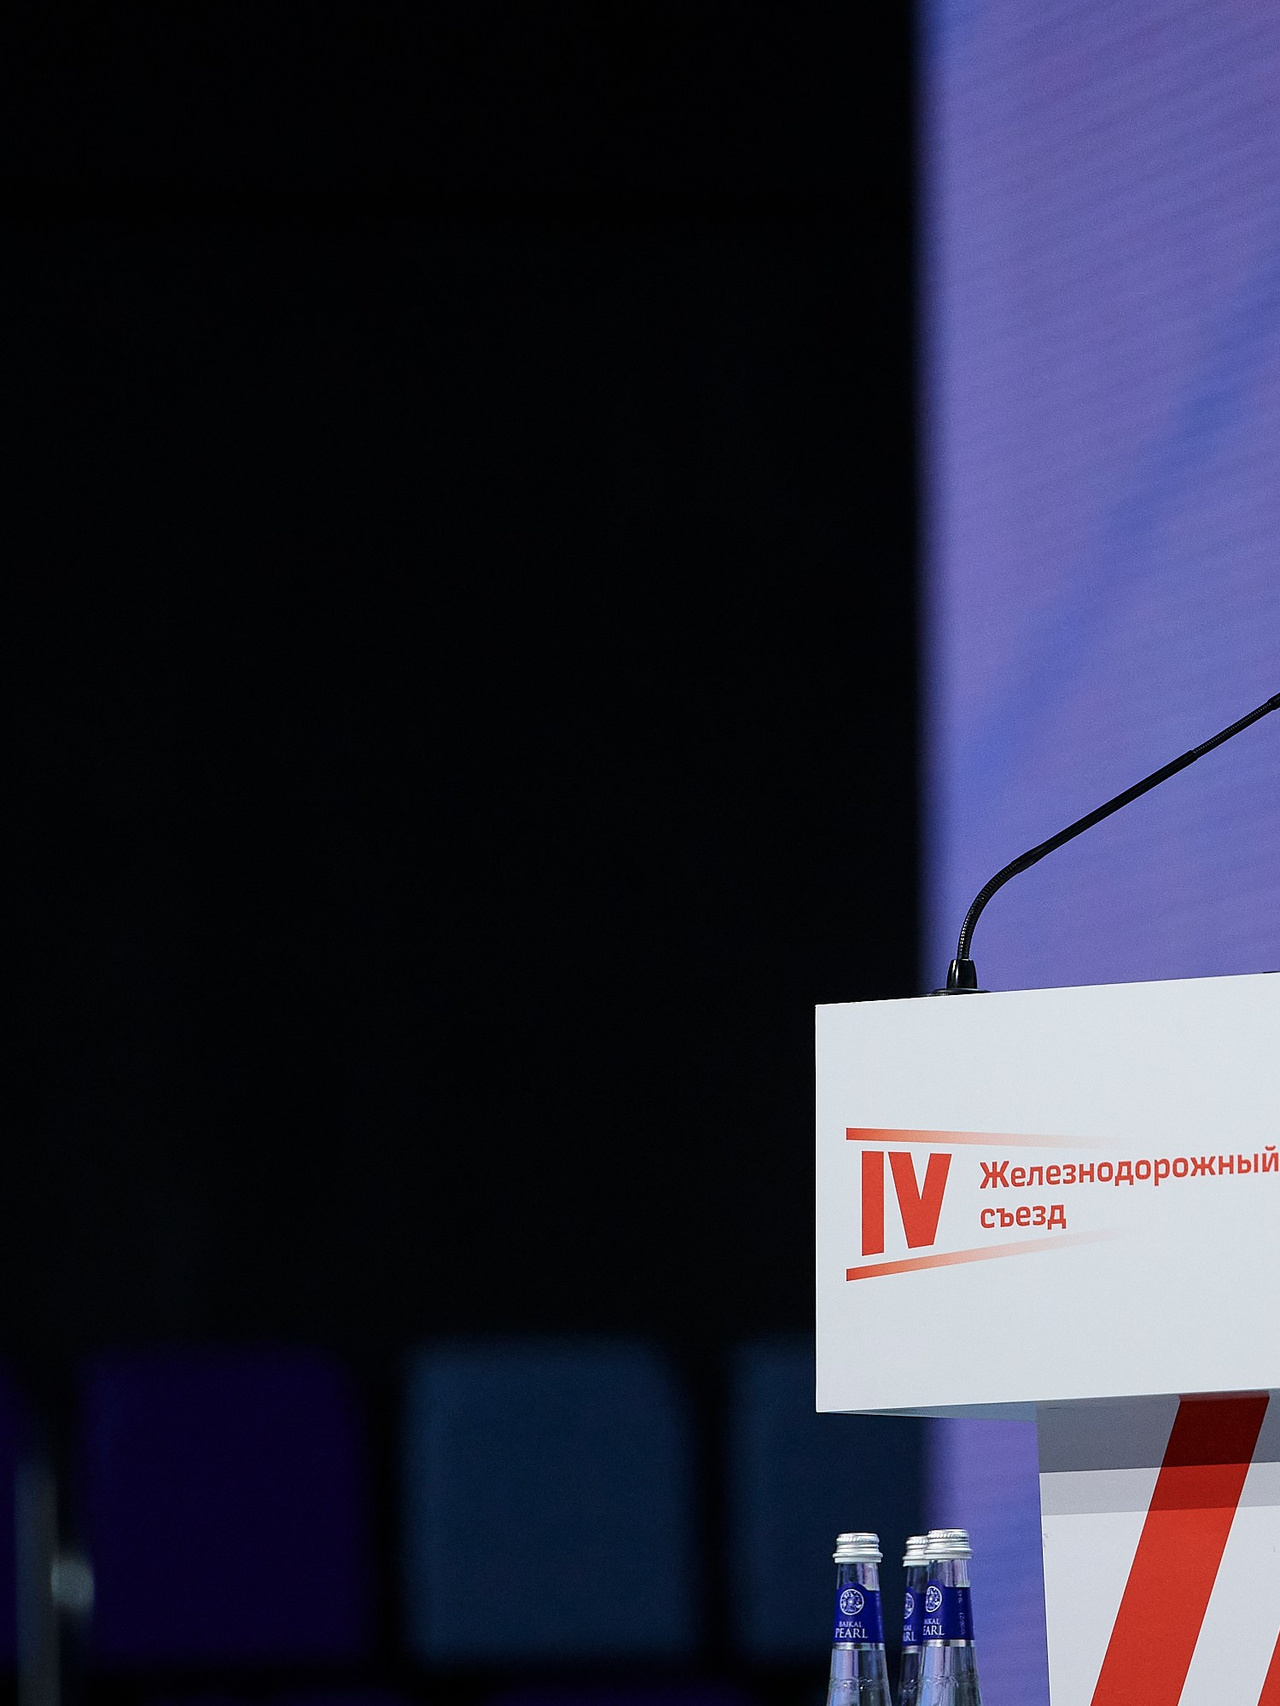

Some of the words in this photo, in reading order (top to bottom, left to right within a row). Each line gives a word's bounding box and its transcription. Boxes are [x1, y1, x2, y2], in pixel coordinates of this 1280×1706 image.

[979, 1144, 1280, 1189] Железнодорожный
[861, 1150, 952, 1257] IV
[980, 1203, 1067, 1230] съезд
[834, 1628, 868, 1639] PEARL
[838, 1620, 862, 1628] BAIKAL
[922, 1625, 945, 1636] EARL
